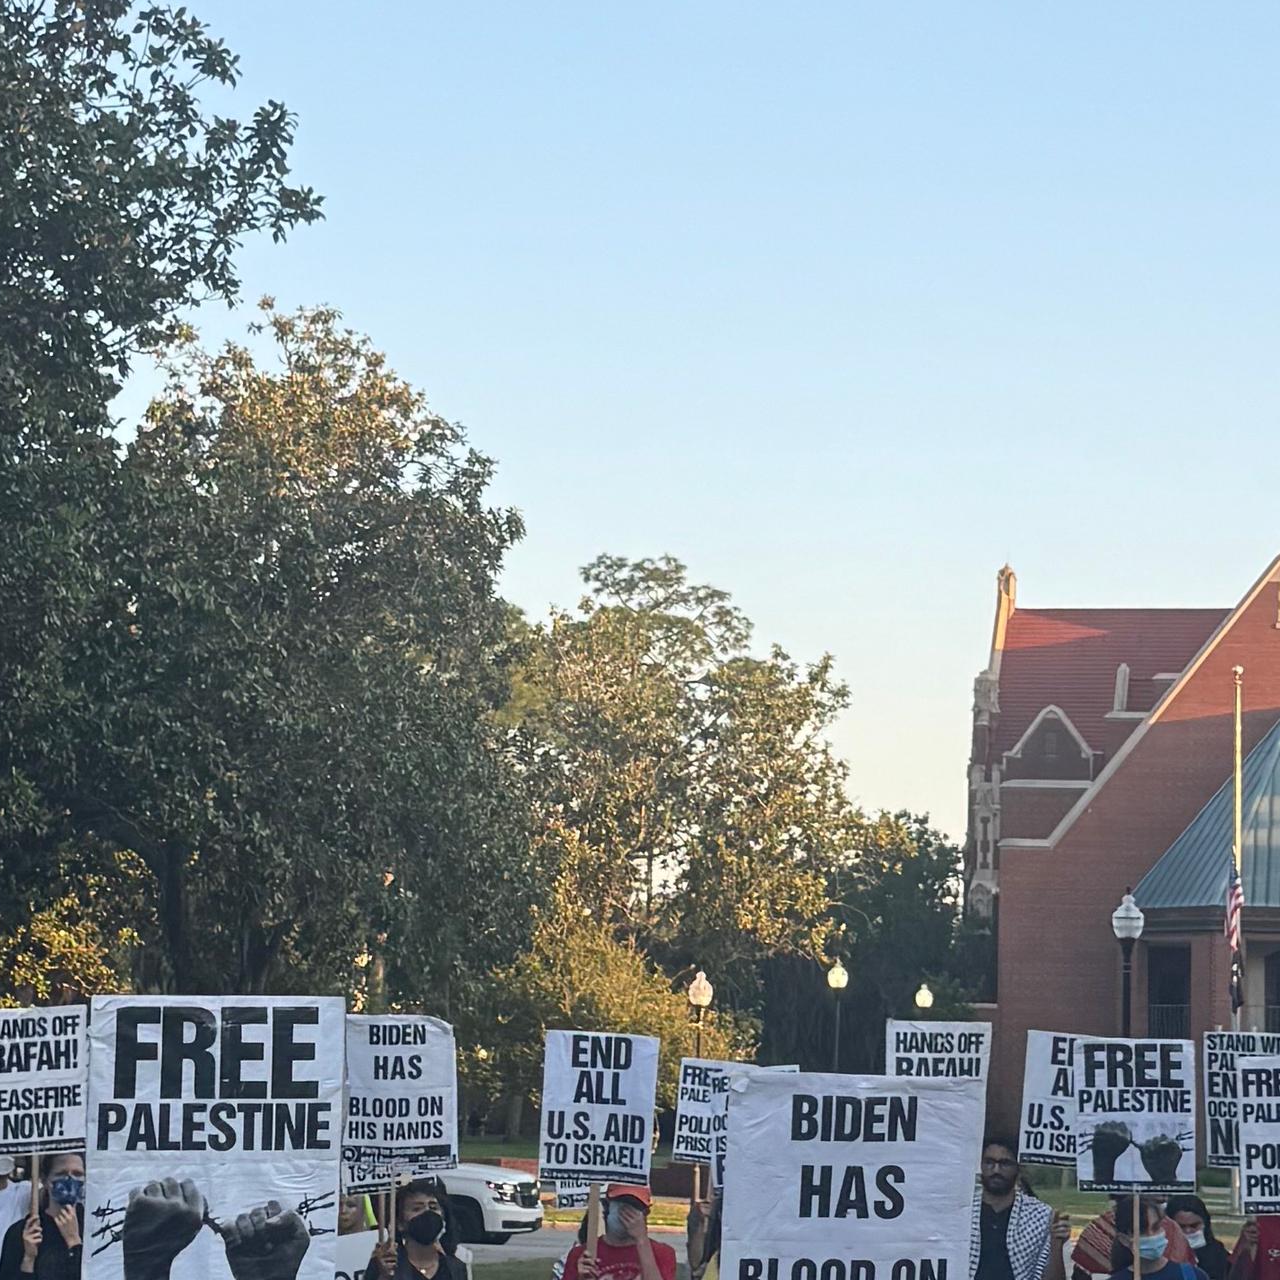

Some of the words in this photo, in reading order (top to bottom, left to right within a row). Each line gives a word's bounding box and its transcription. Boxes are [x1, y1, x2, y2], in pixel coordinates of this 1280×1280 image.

[52, 1015, 80, 1036] OFF
[369, 1024, 427, 1045] BIDEN
[113, 1006, 319, 1099] FREE
[572, 1035, 633, 1070] END
[896, 1032, 954, 1053] HANDS
[958, 1032, 984, 1053] OFF
[1207, 1034, 1256, 1053] STAND
[374, 1054, 423, 1080] HAS
[682, 1065, 723, 1087] FRE
[1083, 1044, 1184, 1088] FREE
[573, 1071, 626, 1106] ALL
[1208, 1072, 1238, 1099] EN
[349, 1097, 410, 1118] BLOOD
[417, 1096, 443, 1116] ON
[1079, 1090, 1191, 1113] PALESTINE
[3, 1111, 64, 1140] NOW!
[97, 1103, 332, 1151] PALESTINE
[548, 1111, 596, 1141] U.S.
[604, 1113, 645, 1144] AID
[791, 1094, 918, 1142] BIDEN
[1027, 1103, 1070, 1131] U.S.
[348, 1121, 377, 1140] HIS
[383, 1121, 443, 1141] HANDS
[1024, 1131, 1044, 1150] TO
[544, 1143, 567, 1164] TO
[574, 1144, 645, 1170] ISRAEL!
[798, 1164, 906, 1219] HAS
